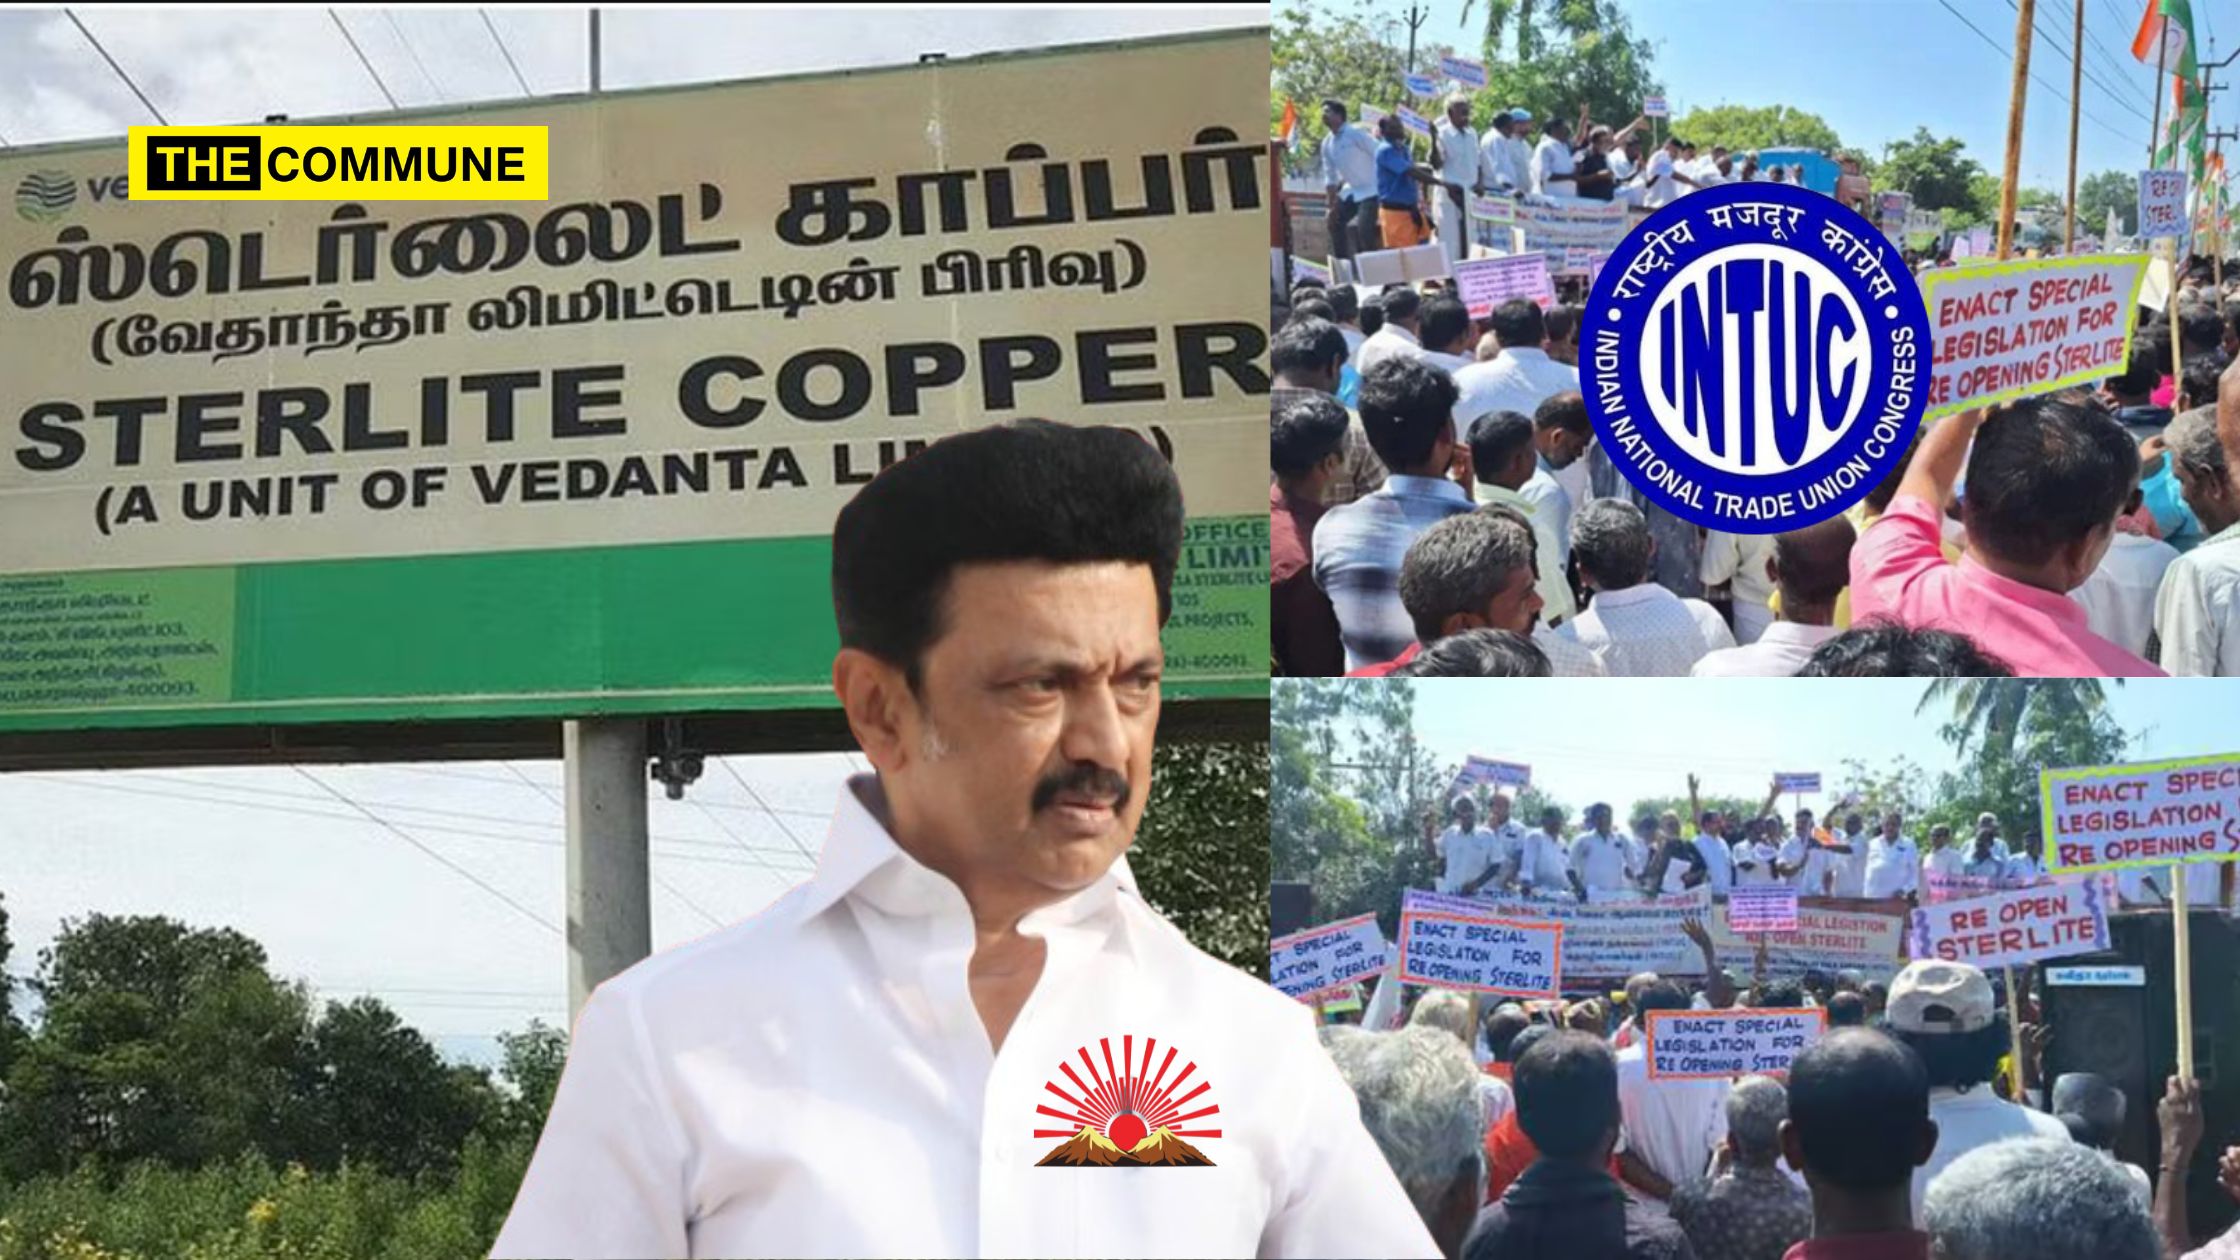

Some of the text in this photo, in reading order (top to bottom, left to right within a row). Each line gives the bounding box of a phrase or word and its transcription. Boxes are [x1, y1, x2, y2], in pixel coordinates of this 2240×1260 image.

[8, 126, 1267, 308] ஸ்டெர்லைட் காப்பர்
[92, 301, 451, 366] (வேதாந்தா
[922, 238, 1147, 296] பிரிவு)
[1939, 273, 2113, 328] ENACT SPECIAL
[1932, 302, 2118, 365] LEGISLATION FOR
[1928, 337, 2126, 404] RE OPENING STERLITE
[15, 321, 1270, 472] STERLITE COPPER
[96, 486, 159, 535] (A
[181, 473, 338, 520] UNIT
[361, 467, 447, 510] OF
[472, 446, 807, 505] VEDANTA
[2064, 781, 2149, 805] ENACT
[2057, 801, 2222, 835] LEGISLATION
[2058, 843, 2096, 867] RE
[2104, 830, 2217, 861] OPENING
[1951, 895, 2068, 933] RE OPEN
[1293, 930, 1351, 956] SPECIAL
[1413, 920, 1528, 944] ENACT SPECIAL
[1936, 916, 2094, 962] STERLITE
[1335, 941, 1363, 960] FOR
[1407, 941, 1542, 966] LEGISLATION FOR
[1408, 958, 1551, 990] RE OPENING STERLITE
[1673, 1017, 1804, 1034] ENACT SPECIAL
[1654, 1035, 1805, 1053] LEGISLATION FOR
[1656, 1054, 1790, 1072] RE OPENING STER
